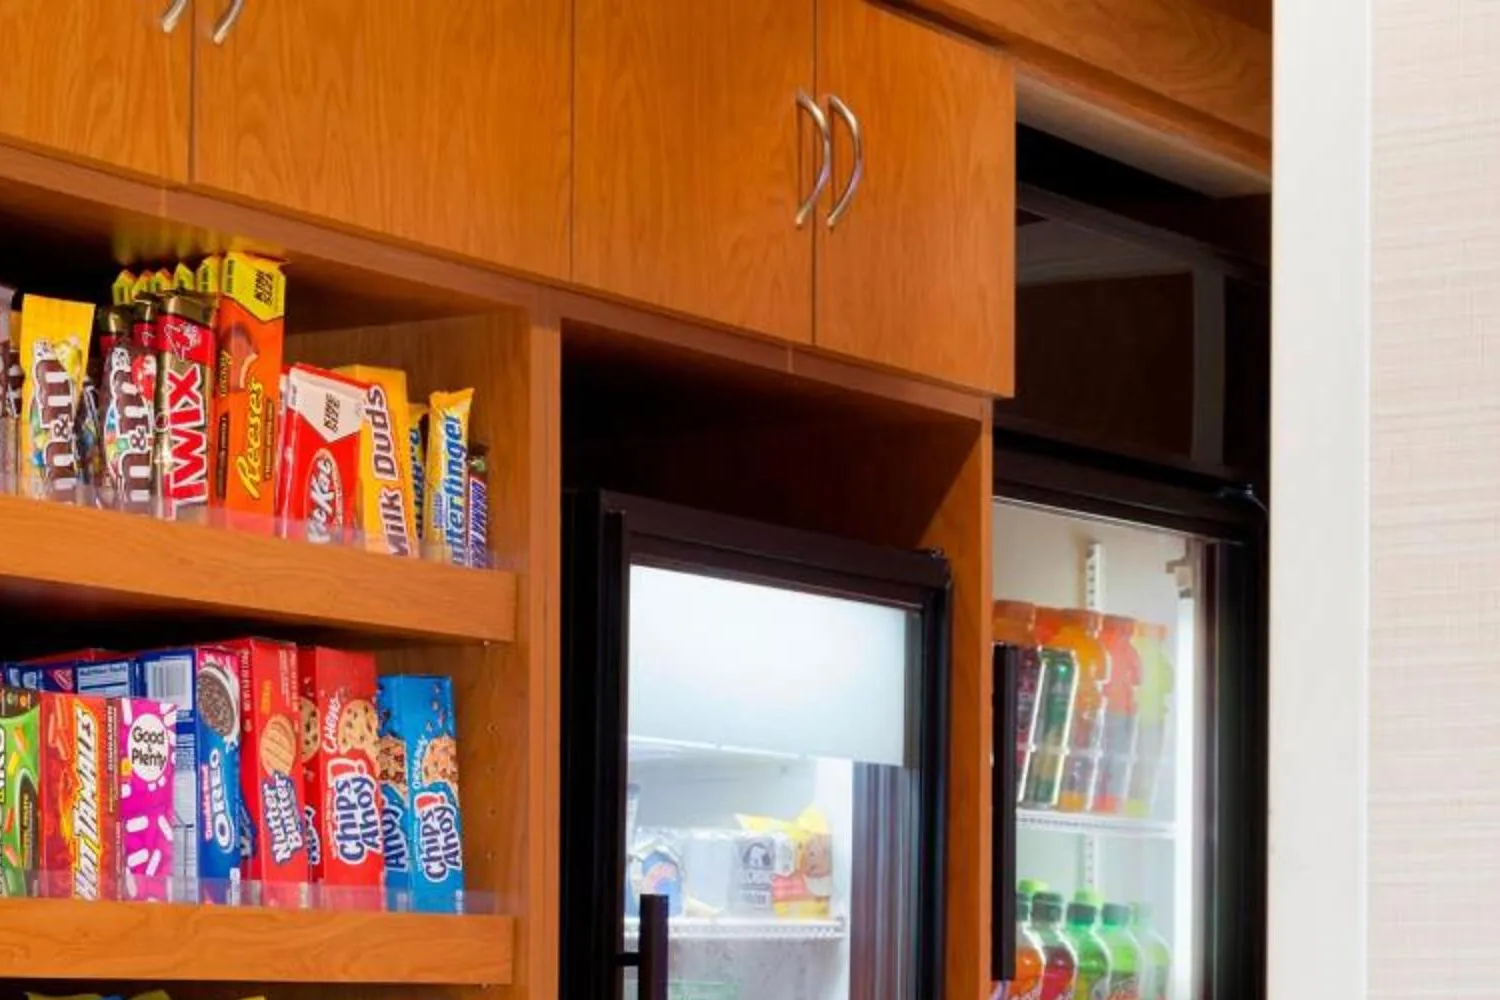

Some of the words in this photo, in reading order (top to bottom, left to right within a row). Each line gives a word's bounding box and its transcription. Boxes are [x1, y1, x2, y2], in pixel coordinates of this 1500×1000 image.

[366, 387, 396, 479] Duds
[131, 726, 165, 745] Good
[131, 751, 166, 769] Plenty
[335, 779, 366, 862] Chips
[419, 809, 448, 881] Chips
